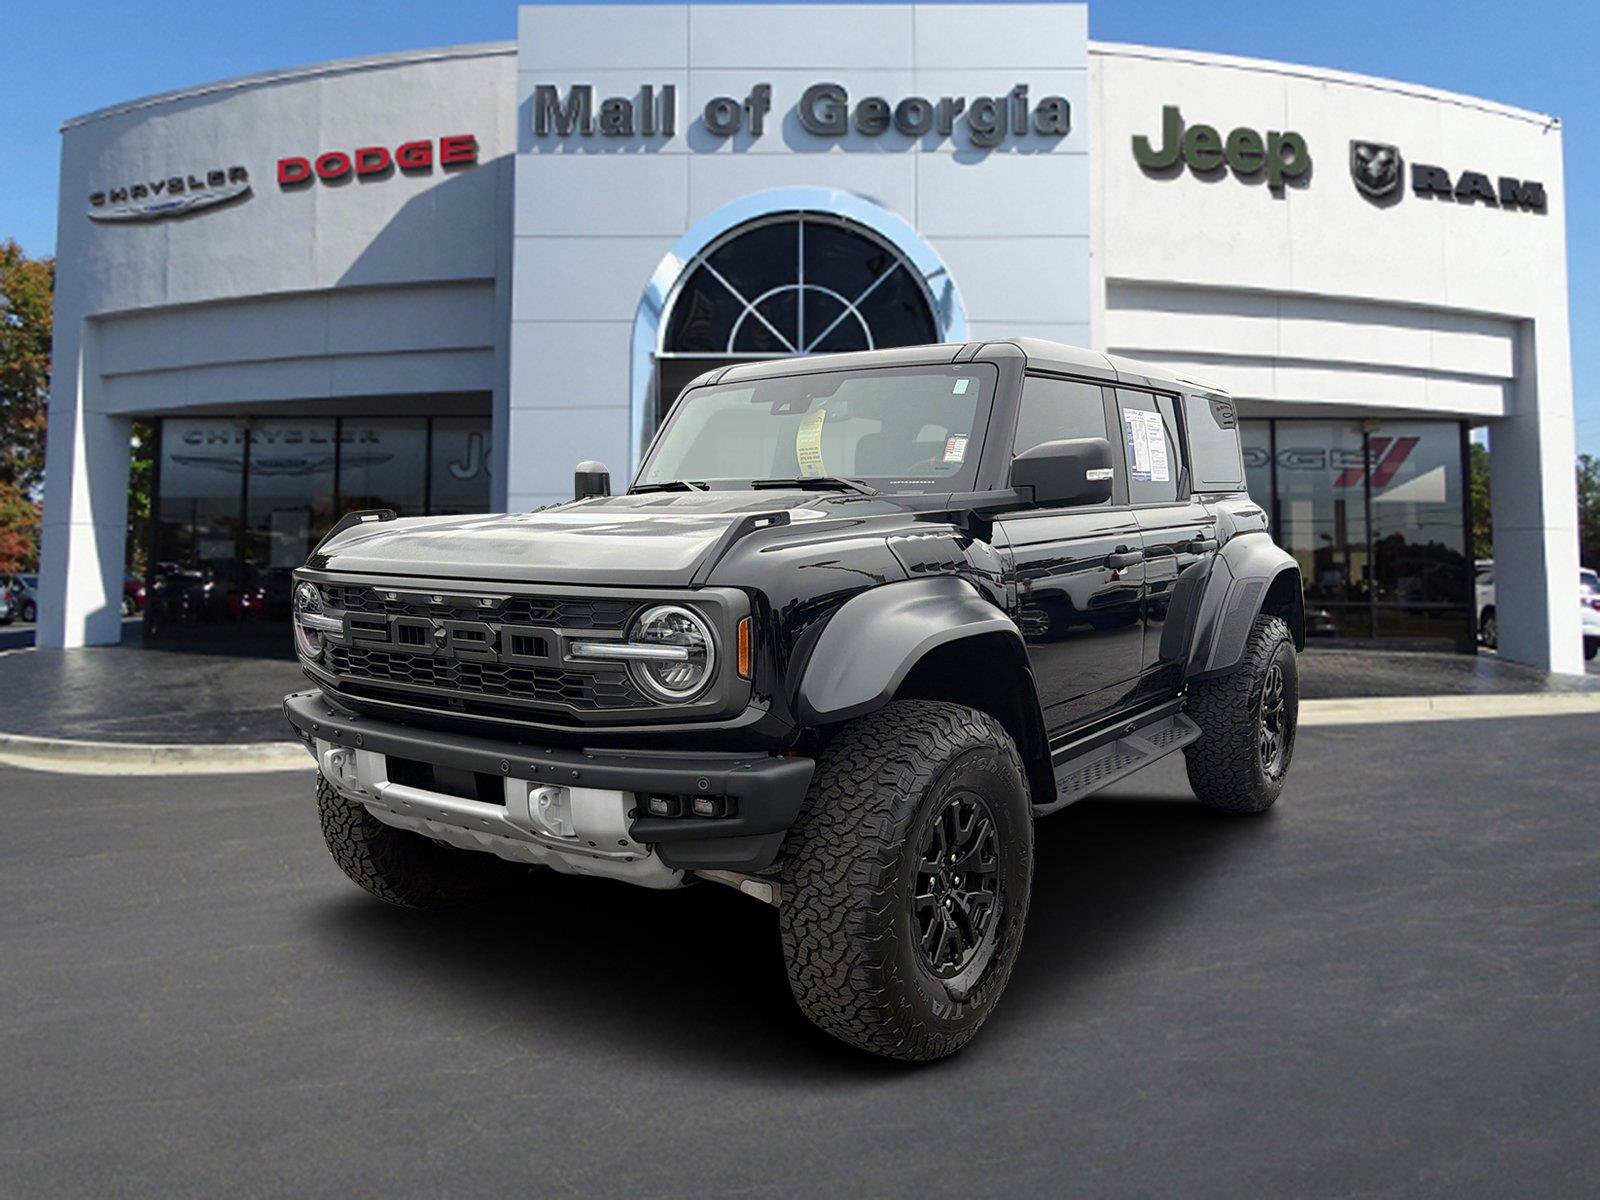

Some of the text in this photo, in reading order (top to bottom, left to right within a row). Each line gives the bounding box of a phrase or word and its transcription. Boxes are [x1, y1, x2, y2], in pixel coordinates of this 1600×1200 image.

[532, 83, 1072, 147] Mall of Georgia
[277, 134, 477, 187] DODGE
[1131, 105, 1310, 199] Jeep
[88, 166, 249, 207] CHRYSLER
[1411, 163, 1549, 214] RAM
[342, 611, 562, 668] FORD
